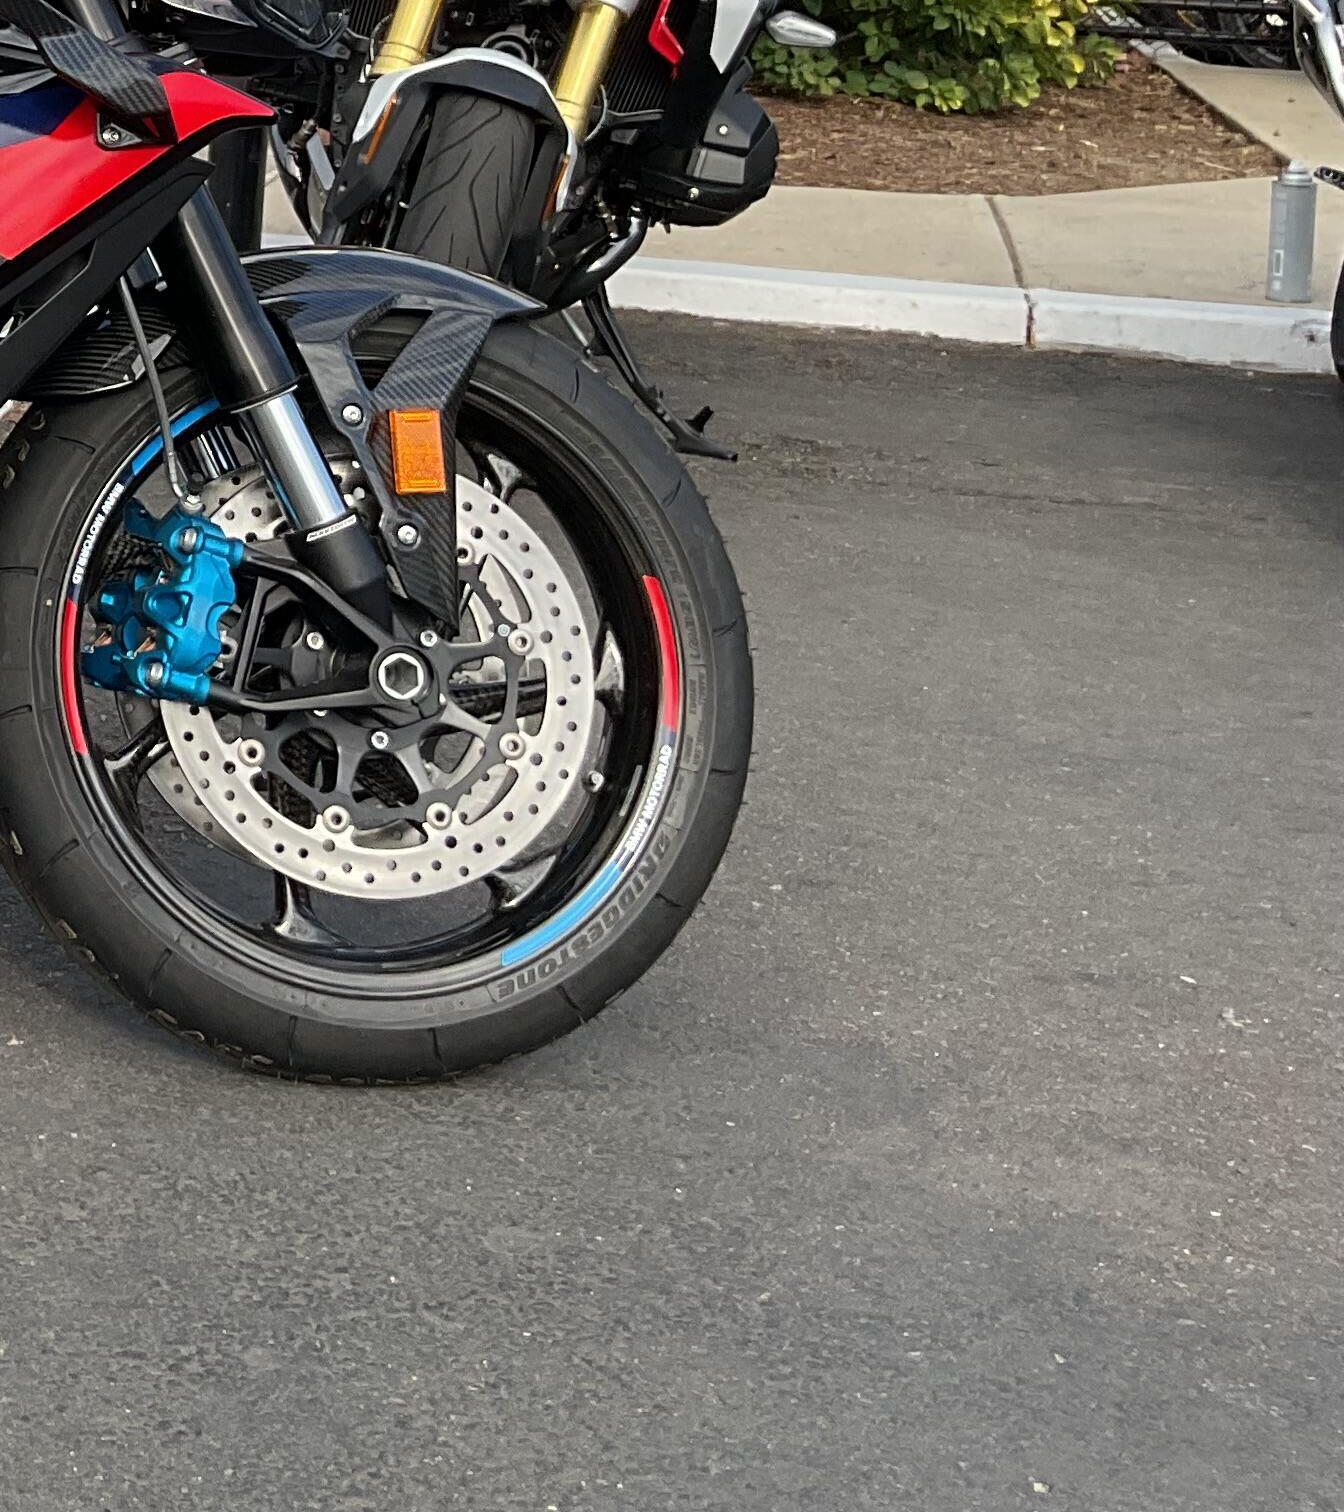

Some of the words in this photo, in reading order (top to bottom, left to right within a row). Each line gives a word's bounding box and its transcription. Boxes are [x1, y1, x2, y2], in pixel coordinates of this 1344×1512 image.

[101, 482, 125, 515] BMW
[72, 512, 106, 585] MOTORRAD
[624, 818, 648, 852] BMW
[641, 744, 673, 820] MOTORRAD
